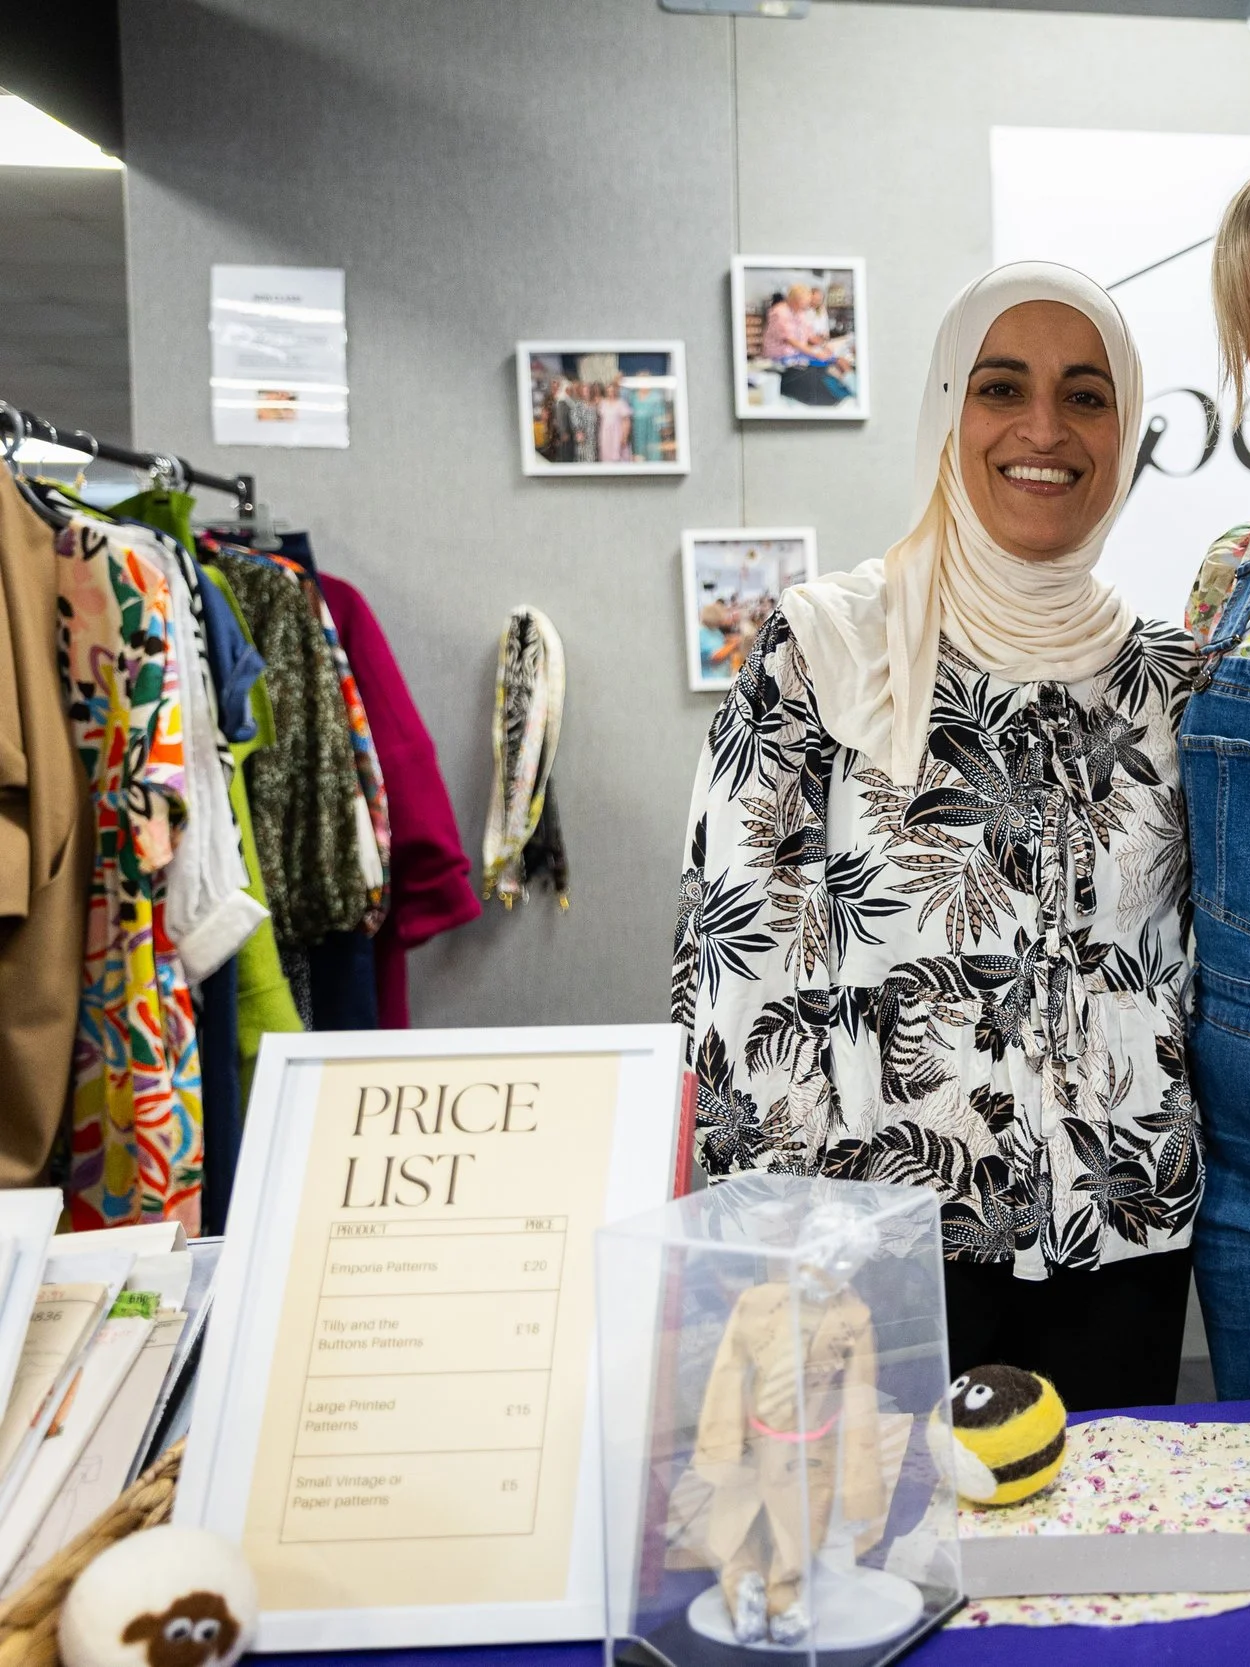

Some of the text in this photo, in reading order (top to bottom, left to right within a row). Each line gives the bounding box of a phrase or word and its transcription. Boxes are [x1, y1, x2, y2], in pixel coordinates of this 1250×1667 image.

[352, 1082, 540, 1136] PRICE
[340, 1153, 476, 1209] LIST
[336, 1219, 555, 1236] PRODUCT PRICE
[330, 1260, 548, 1276] Emporia Patterns £20
[322, 1318, 400, 1333] Tilly and the
[318, 1336, 424, 1351] Buttons Patterns
[308, 1399, 396, 1415] Large Printed
[304, 1420, 359, 1433] Patterns
[296, 1475, 332, 1489] Small
[336, 1474, 386, 1489] Vintage
[501, 1479, 518, 1492] £5
[292, 1494, 390, 1511] Paper patterns
